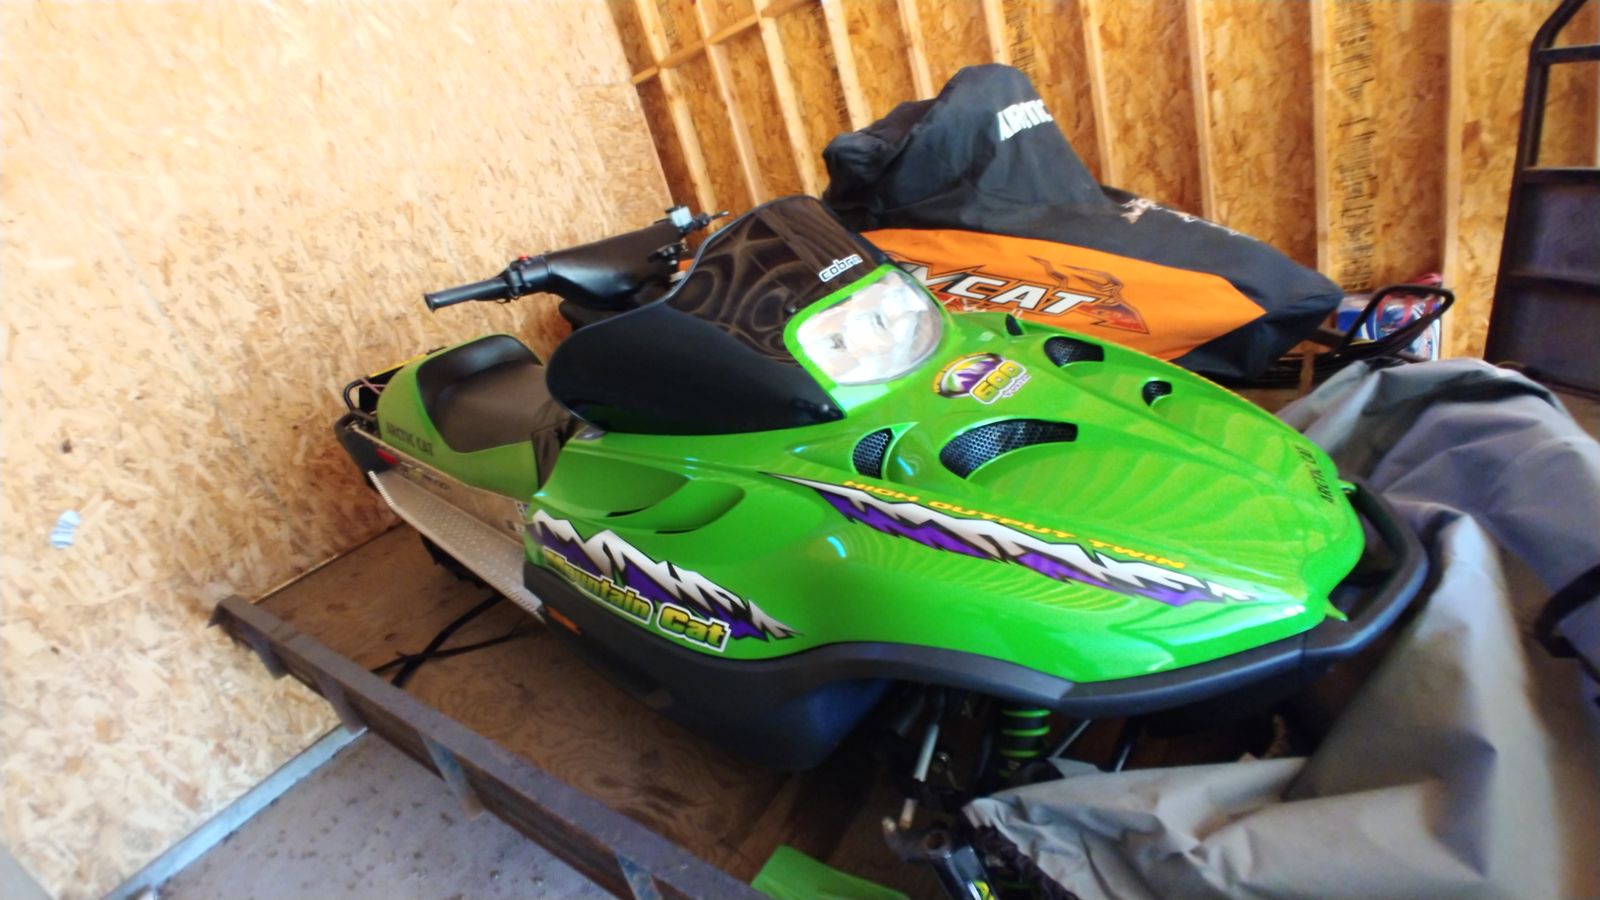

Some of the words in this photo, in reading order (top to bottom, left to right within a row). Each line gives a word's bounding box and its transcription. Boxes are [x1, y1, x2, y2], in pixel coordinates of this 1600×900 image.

[970, 361, 1026, 404] 600
[841, 480, 919, 502] HIGH
[927, 501, 1076, 539] OUTPUT
[1088, 539, 1186, 569] TWIN
[543, 546, 653, 624] Mountain
[657, 603, 731, 653] Cat
